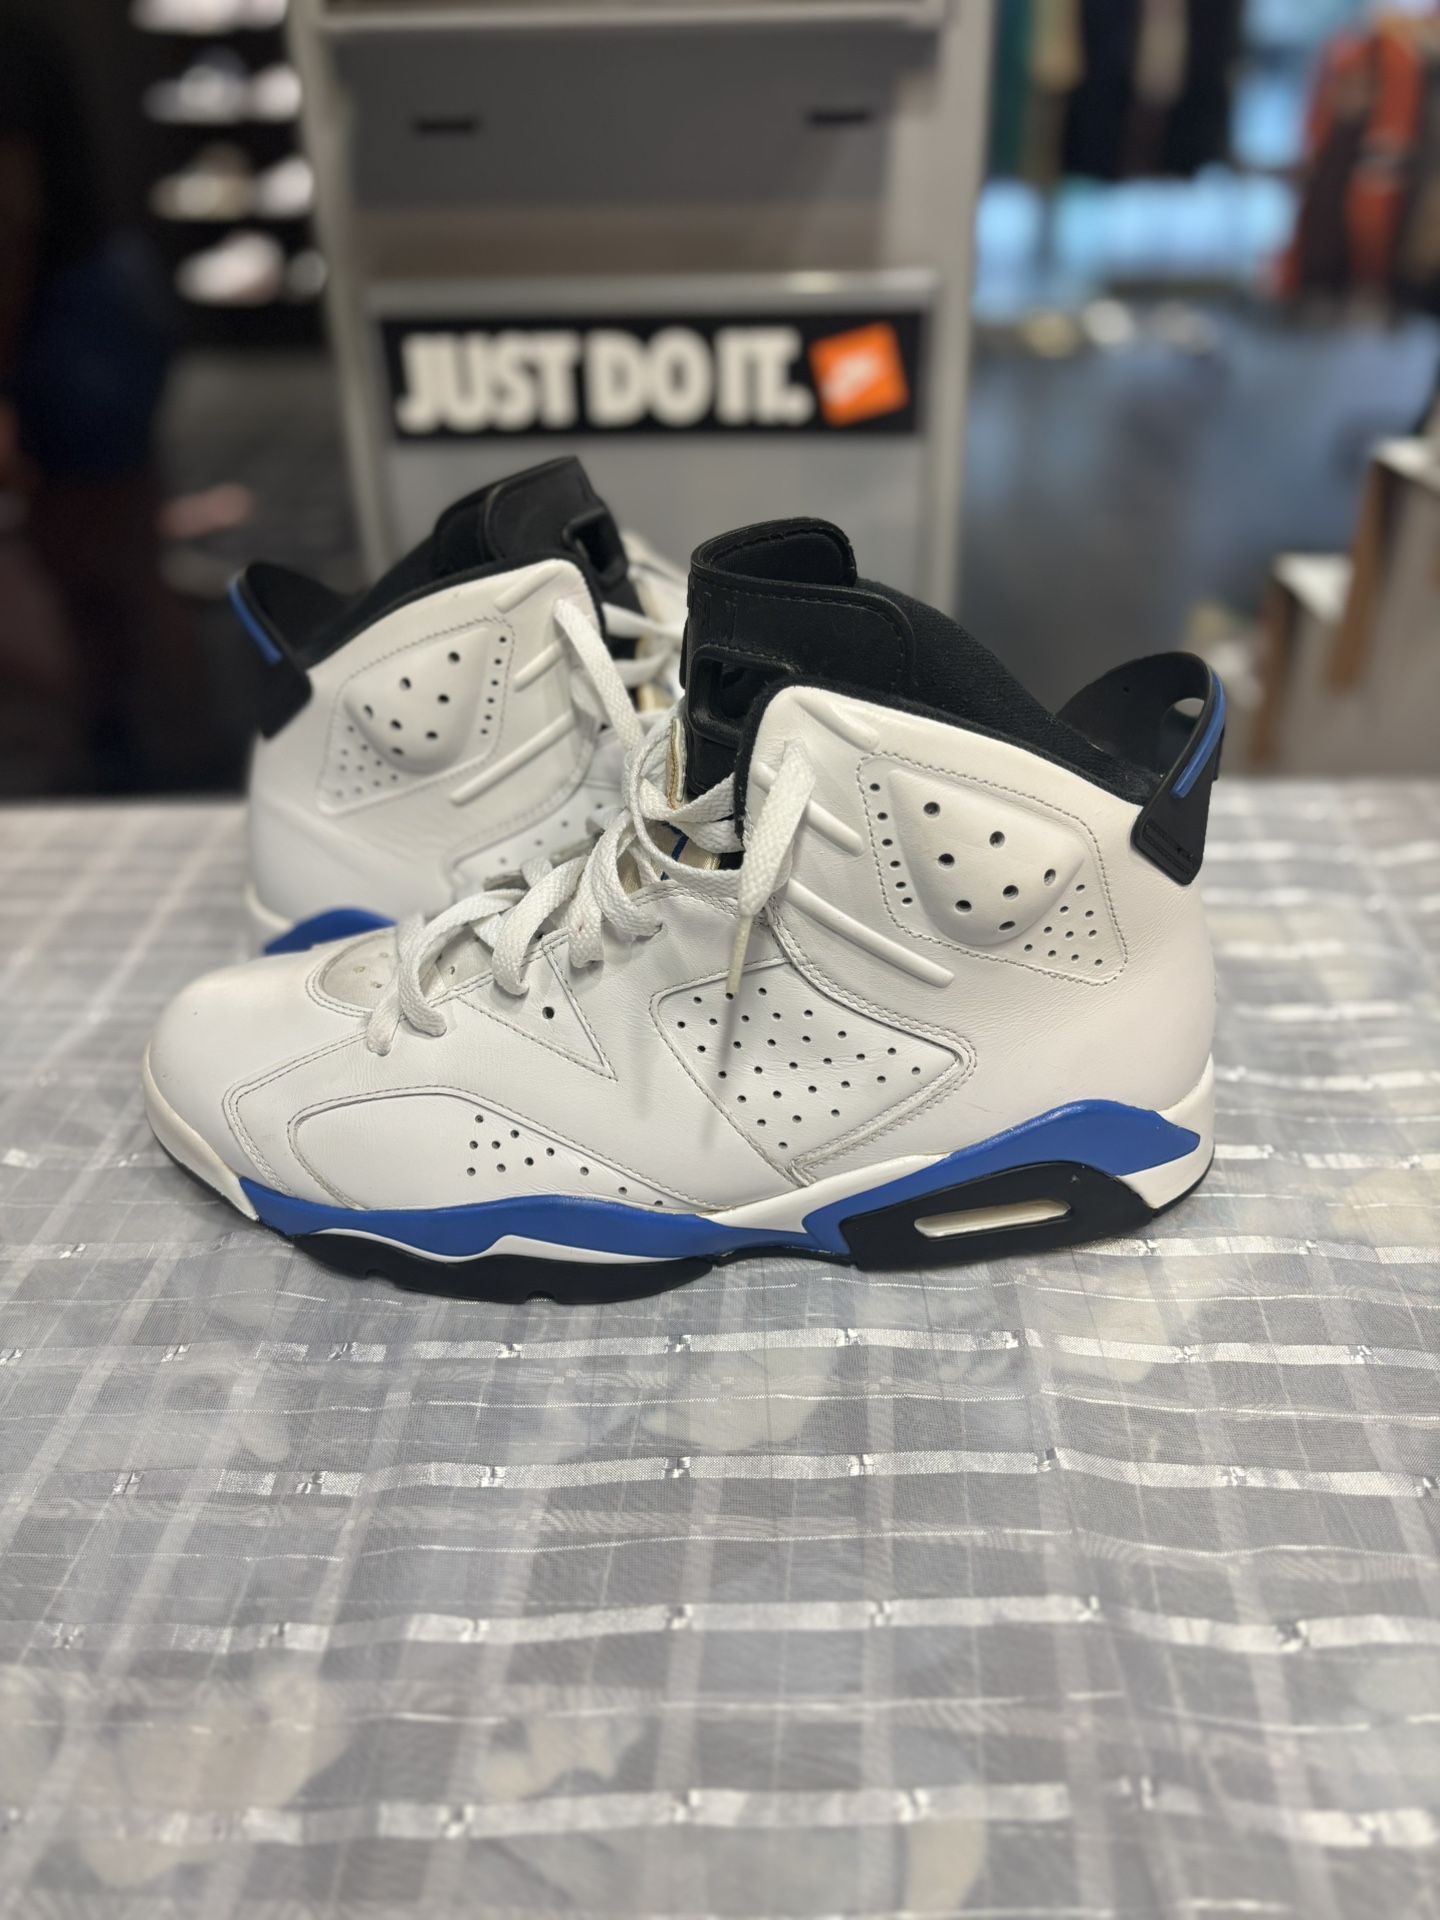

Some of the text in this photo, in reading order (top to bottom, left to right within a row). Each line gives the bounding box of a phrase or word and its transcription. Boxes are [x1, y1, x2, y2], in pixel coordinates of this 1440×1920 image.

[397, 330, 582, 432] JUST
[584, 327, 714, 426] DO
[715, 326, 815, 426] IT.
